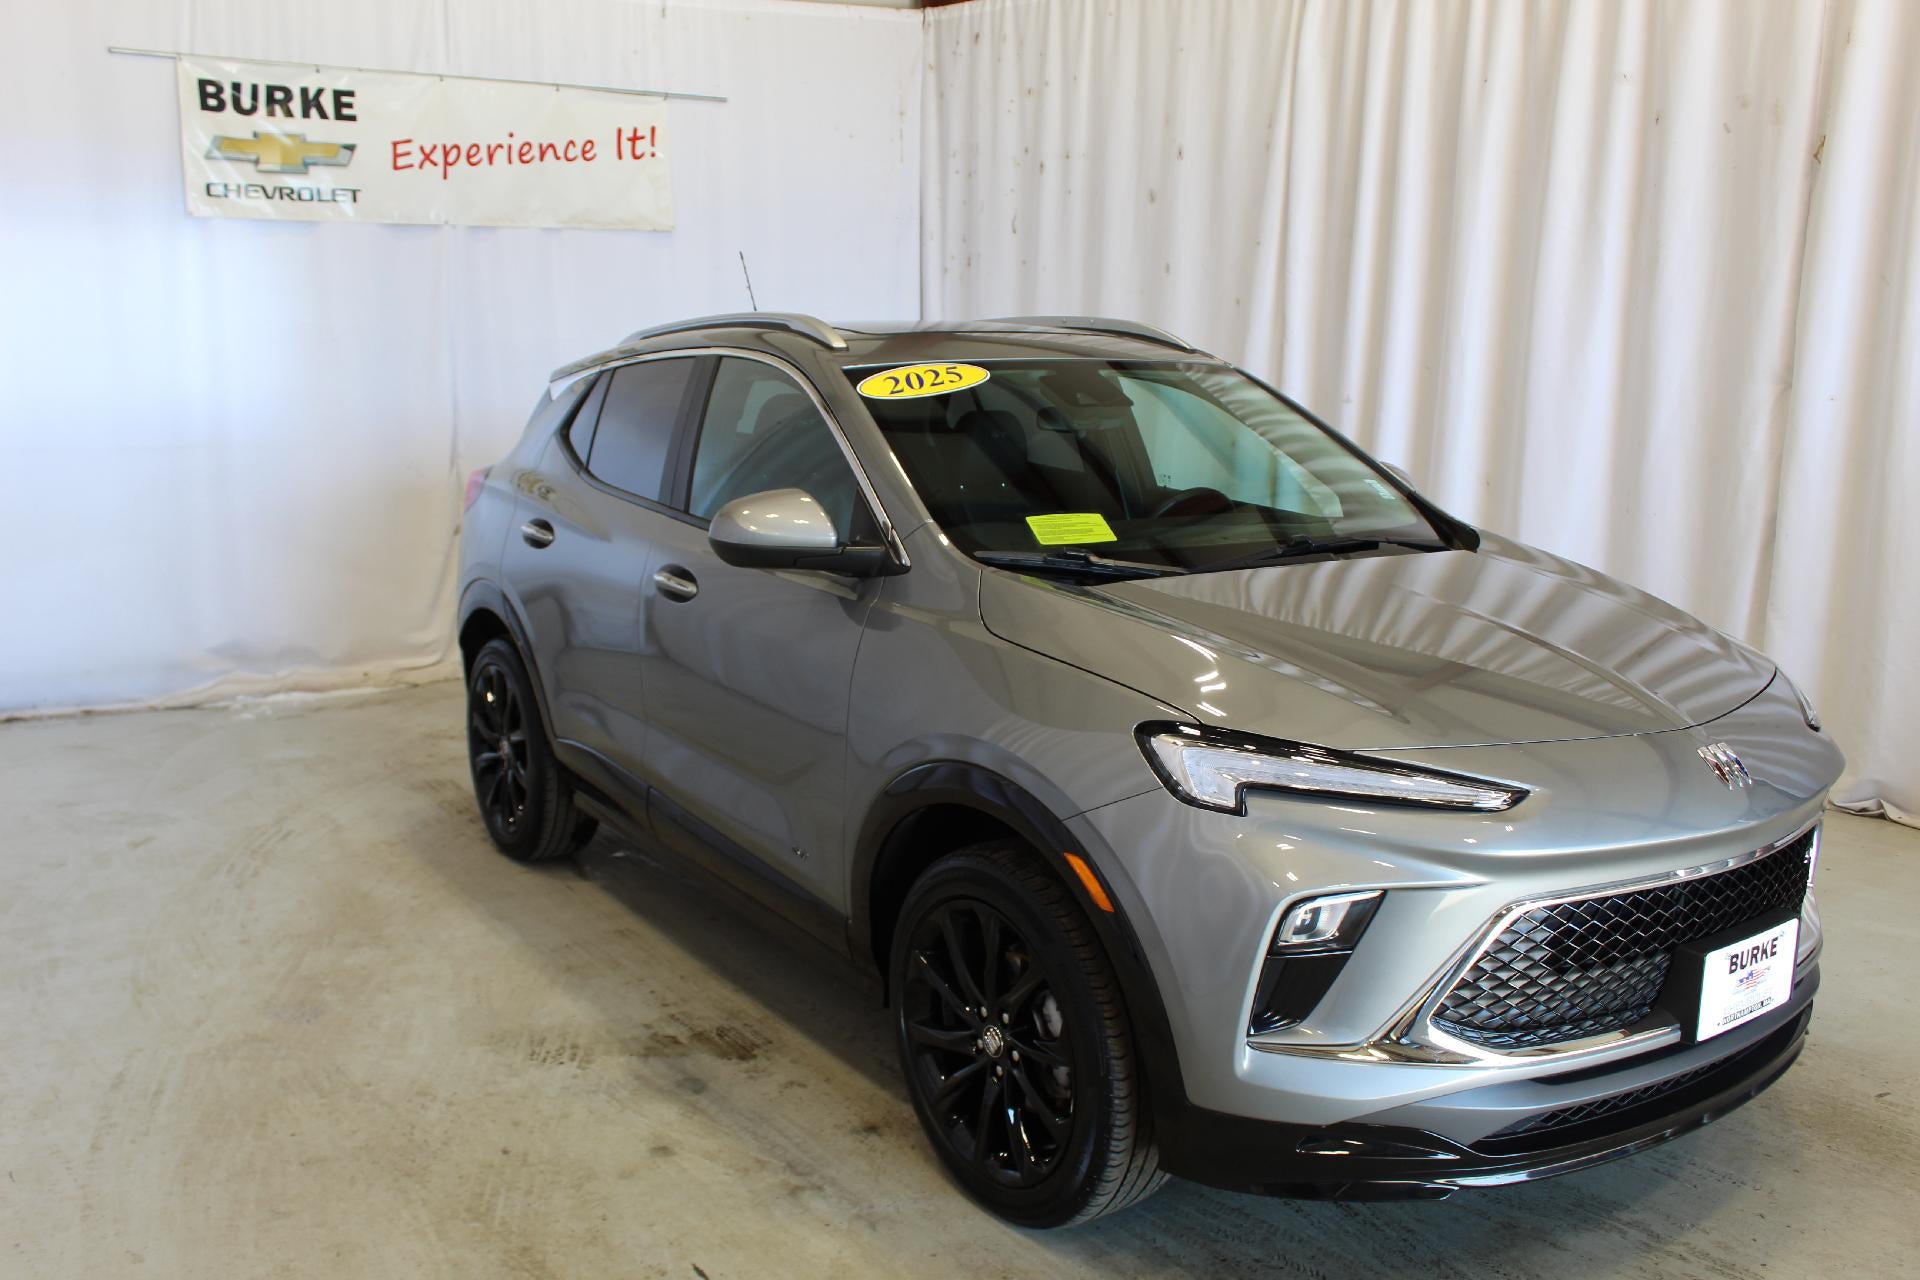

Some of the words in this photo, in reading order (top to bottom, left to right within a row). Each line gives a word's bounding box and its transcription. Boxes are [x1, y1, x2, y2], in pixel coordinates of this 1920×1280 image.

[197, 78, 358, 121] BURKE
[391, 132, 597, 180] Experience
[615, 126, 656, 160] It!
[206, 183, 361, 203] CHEVROLET
[884, 366, 963, 395] 2025
[1728, 936, 1779, 974] BURKE
